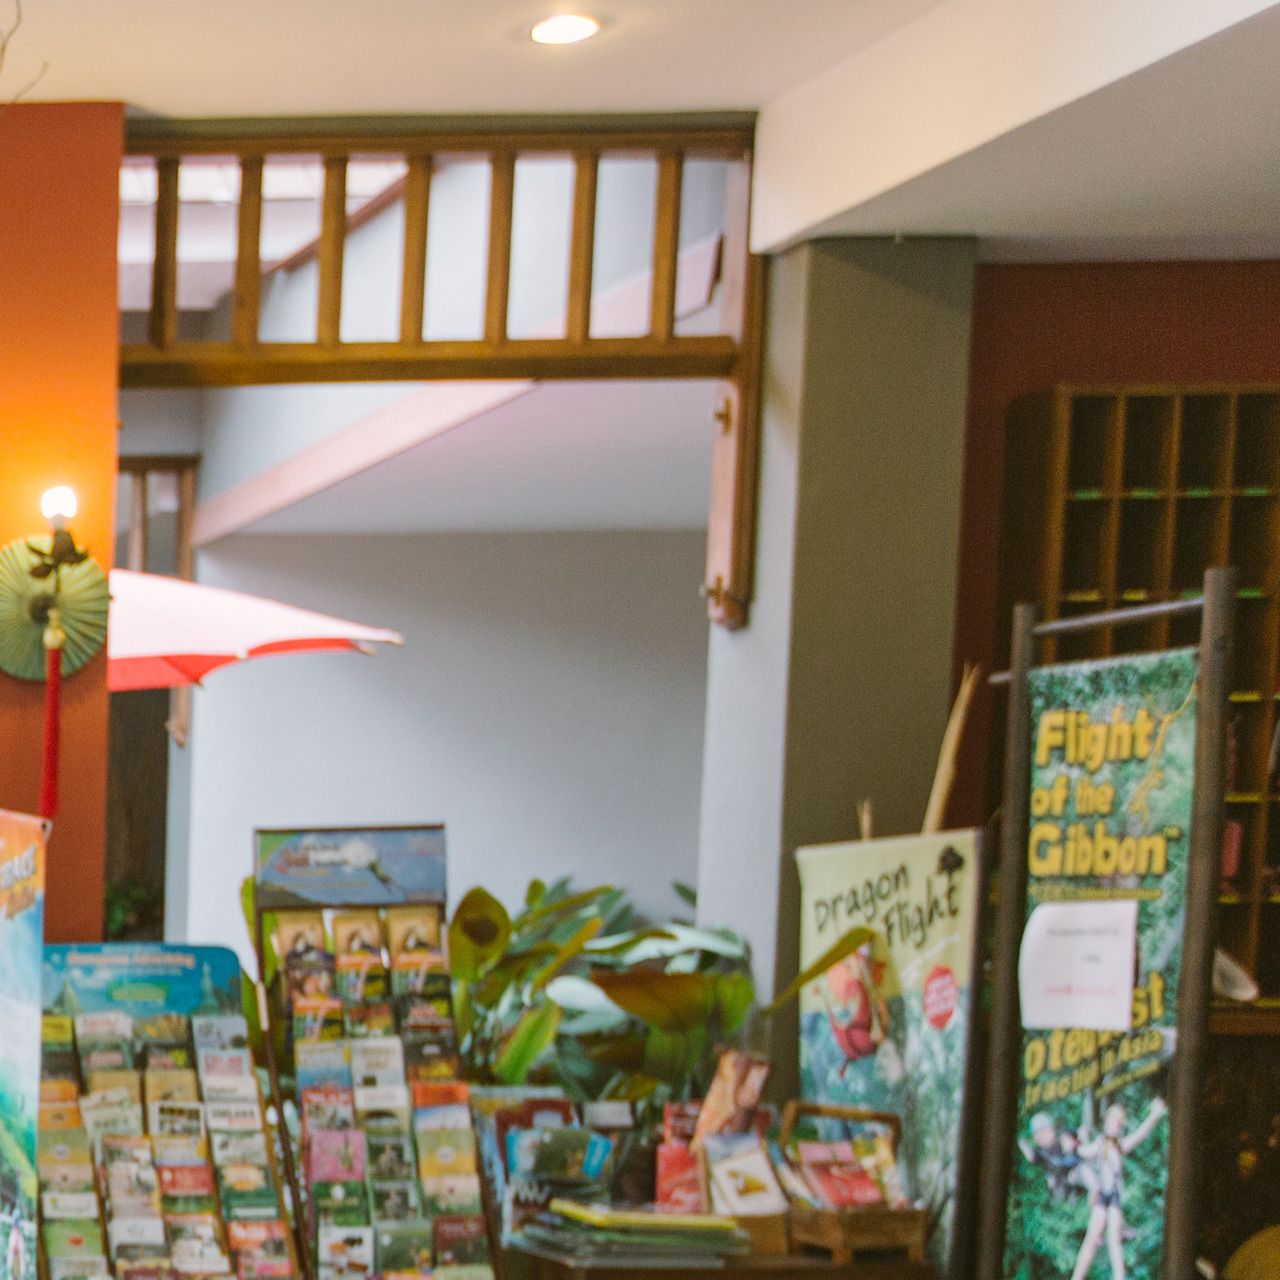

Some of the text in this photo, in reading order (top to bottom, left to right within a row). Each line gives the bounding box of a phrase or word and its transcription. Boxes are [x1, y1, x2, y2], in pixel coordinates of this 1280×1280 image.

[1035, 705, 1155, 773] Flight
[1031, 774, 1115, 817] of the
[813, 862, 910, 932] Dragon
[883, 874, 959, 950] Flight
